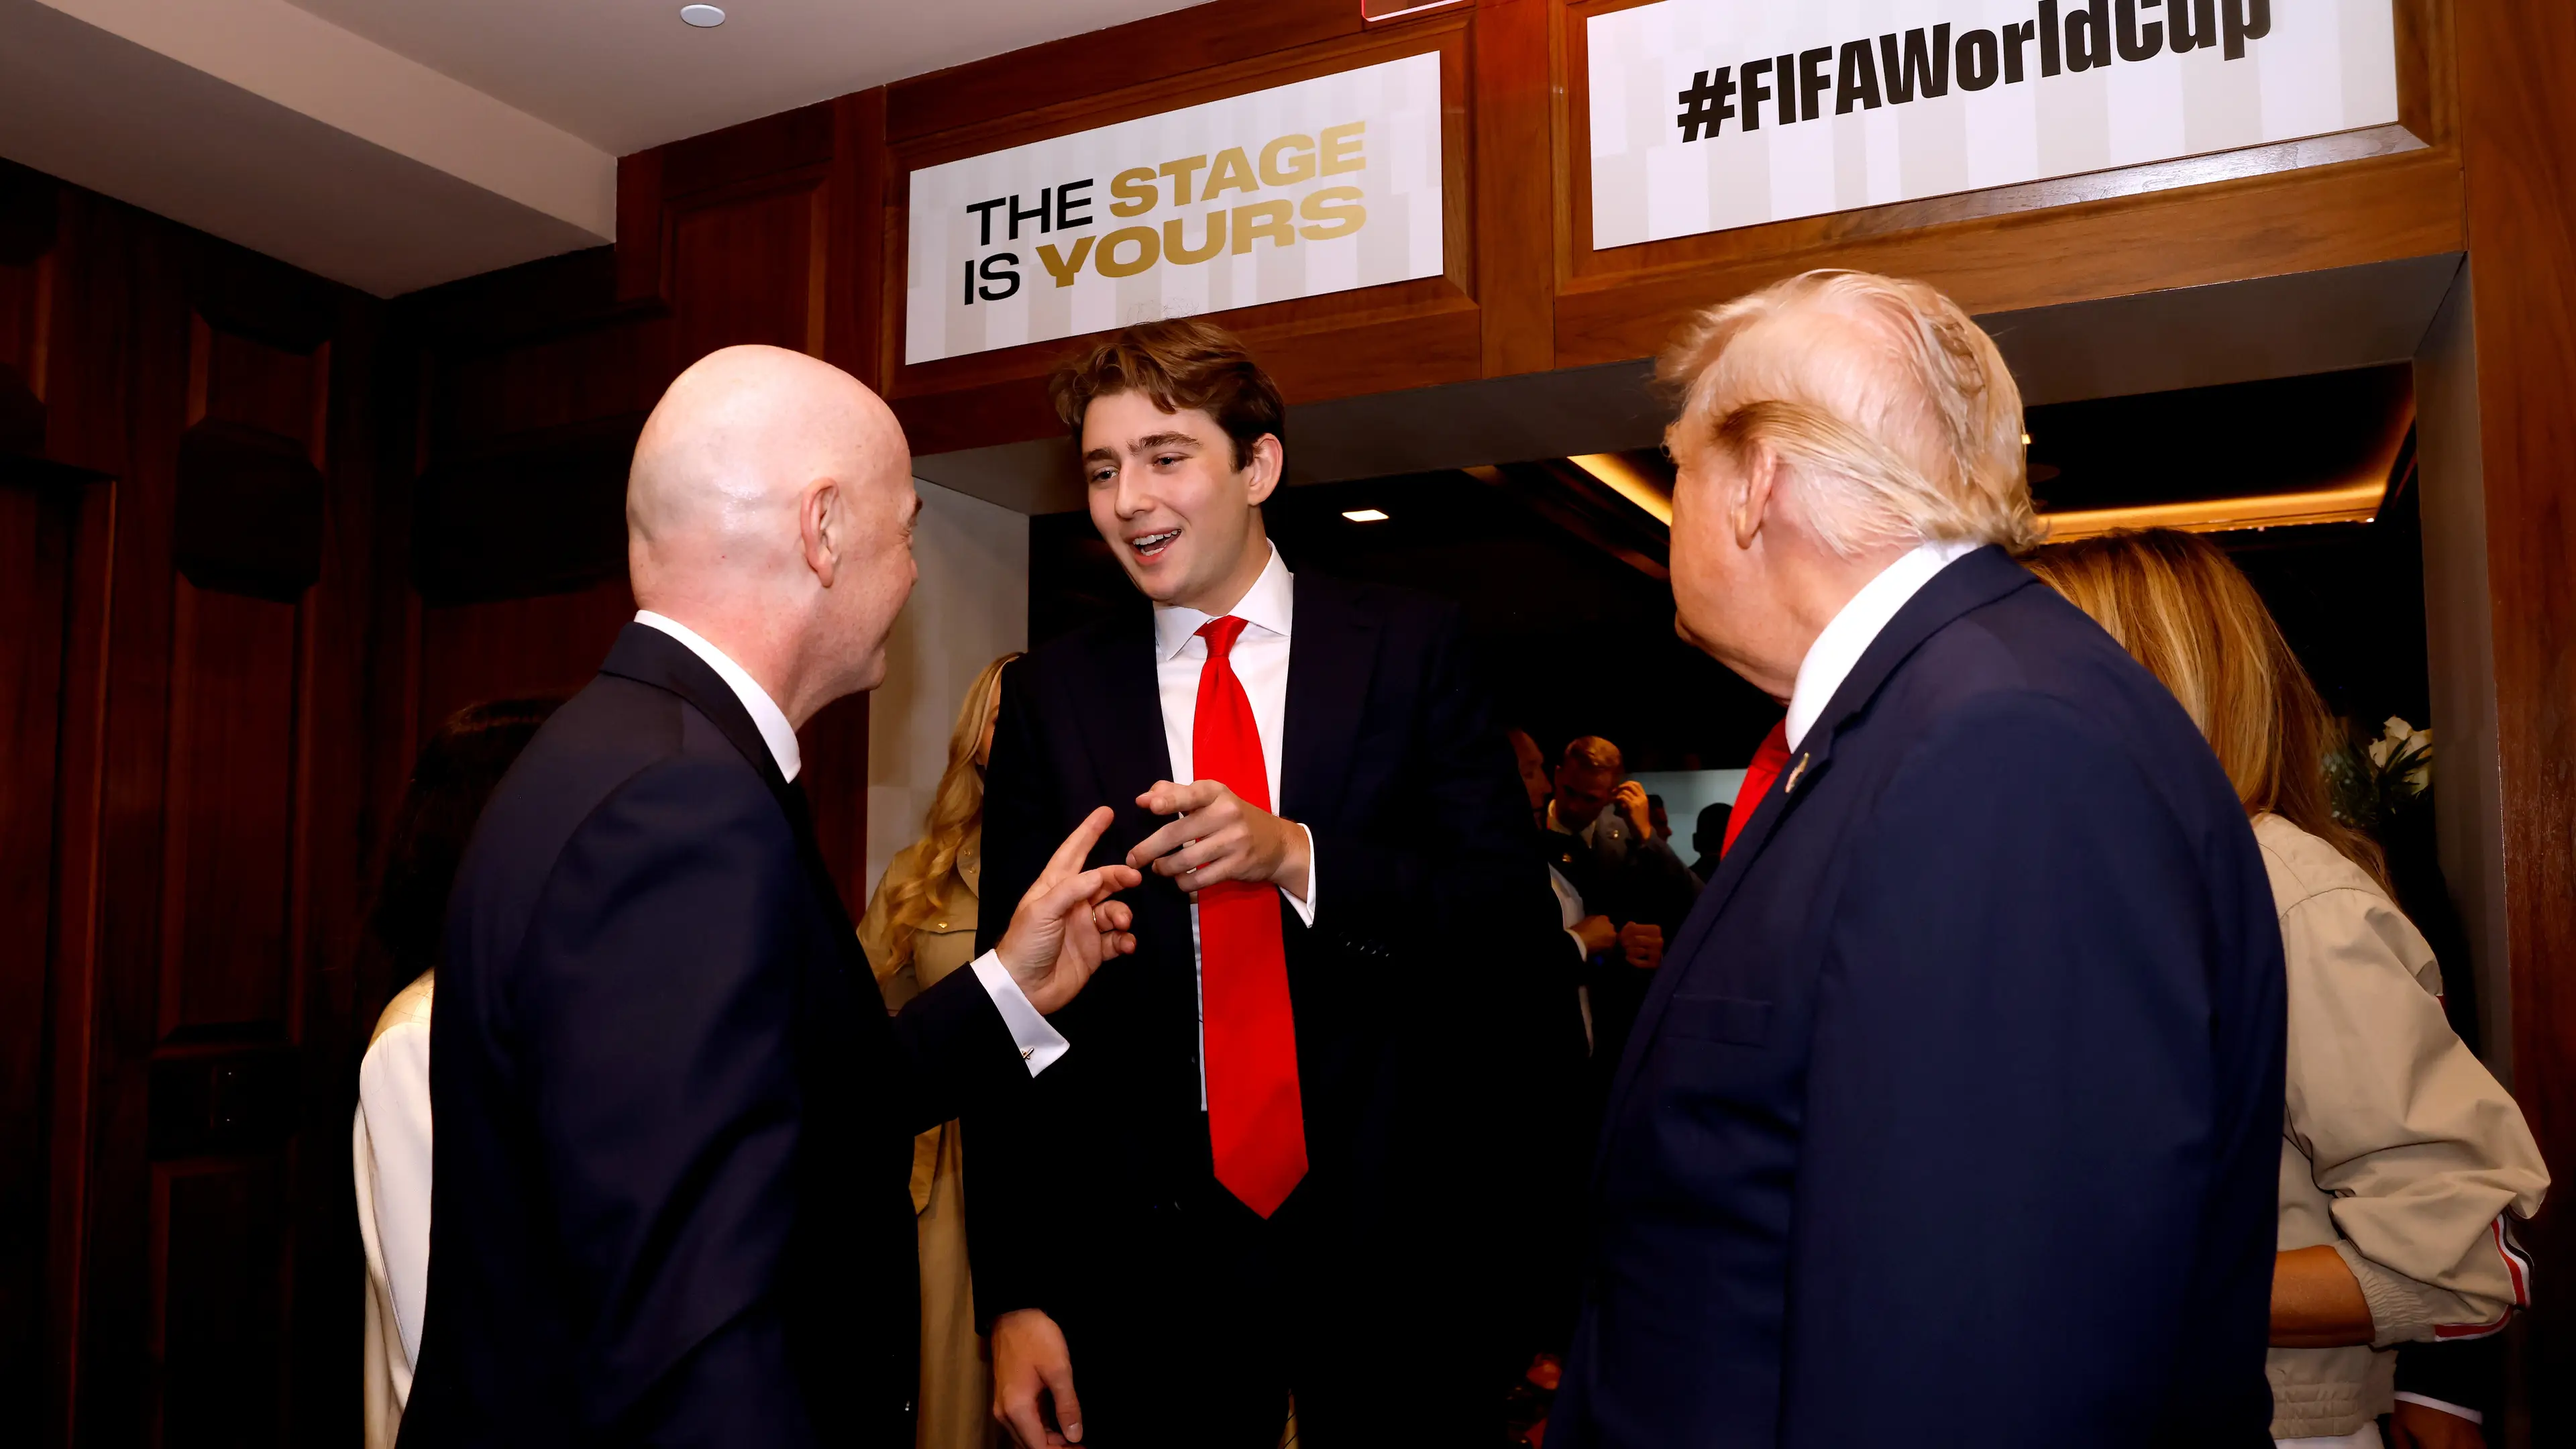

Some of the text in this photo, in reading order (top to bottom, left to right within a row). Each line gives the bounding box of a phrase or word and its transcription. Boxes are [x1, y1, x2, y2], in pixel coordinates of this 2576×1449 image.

[1677, 0, 2271, 144] #FIFAWorldCup
[963, 185, 1367, 306] IS YOURS
[966, 121, 1366, 246] THE STAGE
